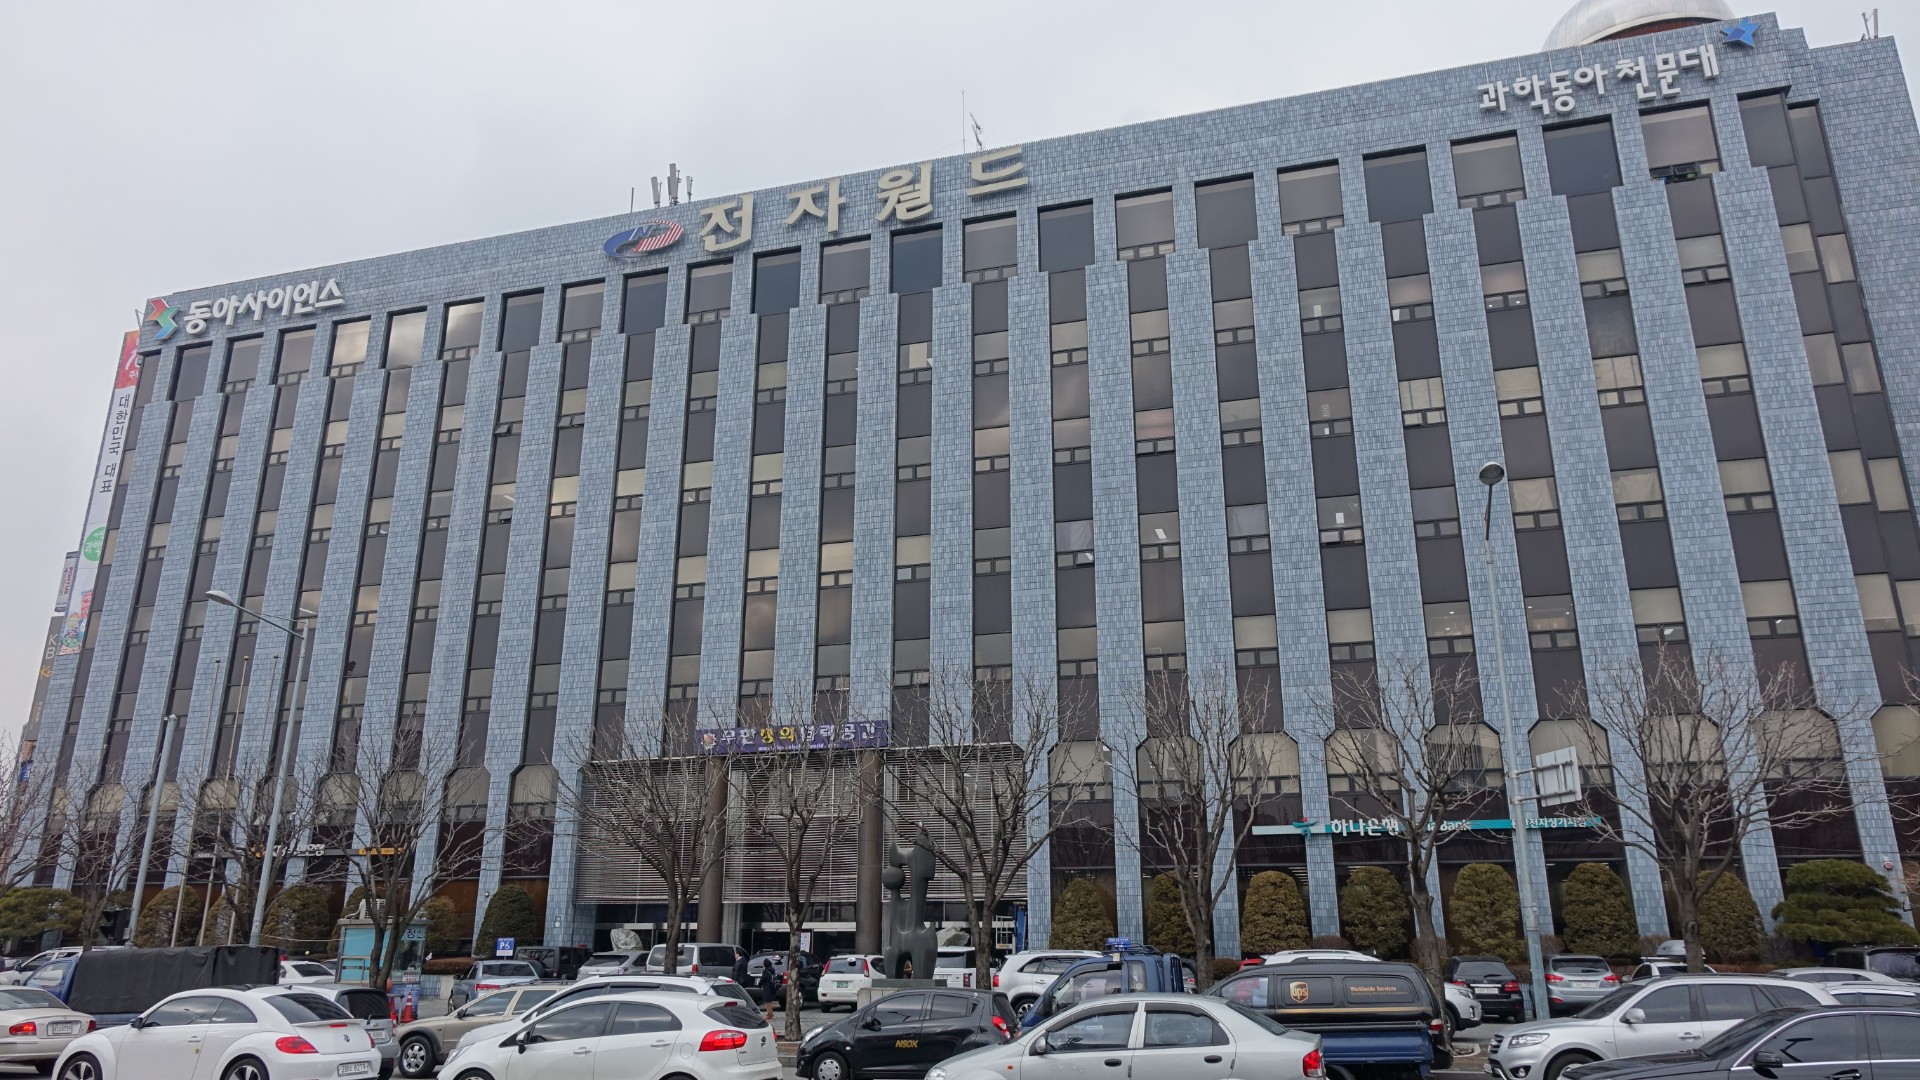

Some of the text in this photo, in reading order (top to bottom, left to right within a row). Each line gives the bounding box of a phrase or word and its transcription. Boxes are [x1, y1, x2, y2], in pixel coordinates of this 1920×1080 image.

[700, 146, 1029, 252] 전자월드
[184, 278, 346, 335] 동아사이언스
[99, 394, 130, 493] 대한민국 대표
[1331, 817, 1399, 836] 하나은행
[1292, 986, 1308, 999] ups
[895, 1040, 919, 1048] NSOK
